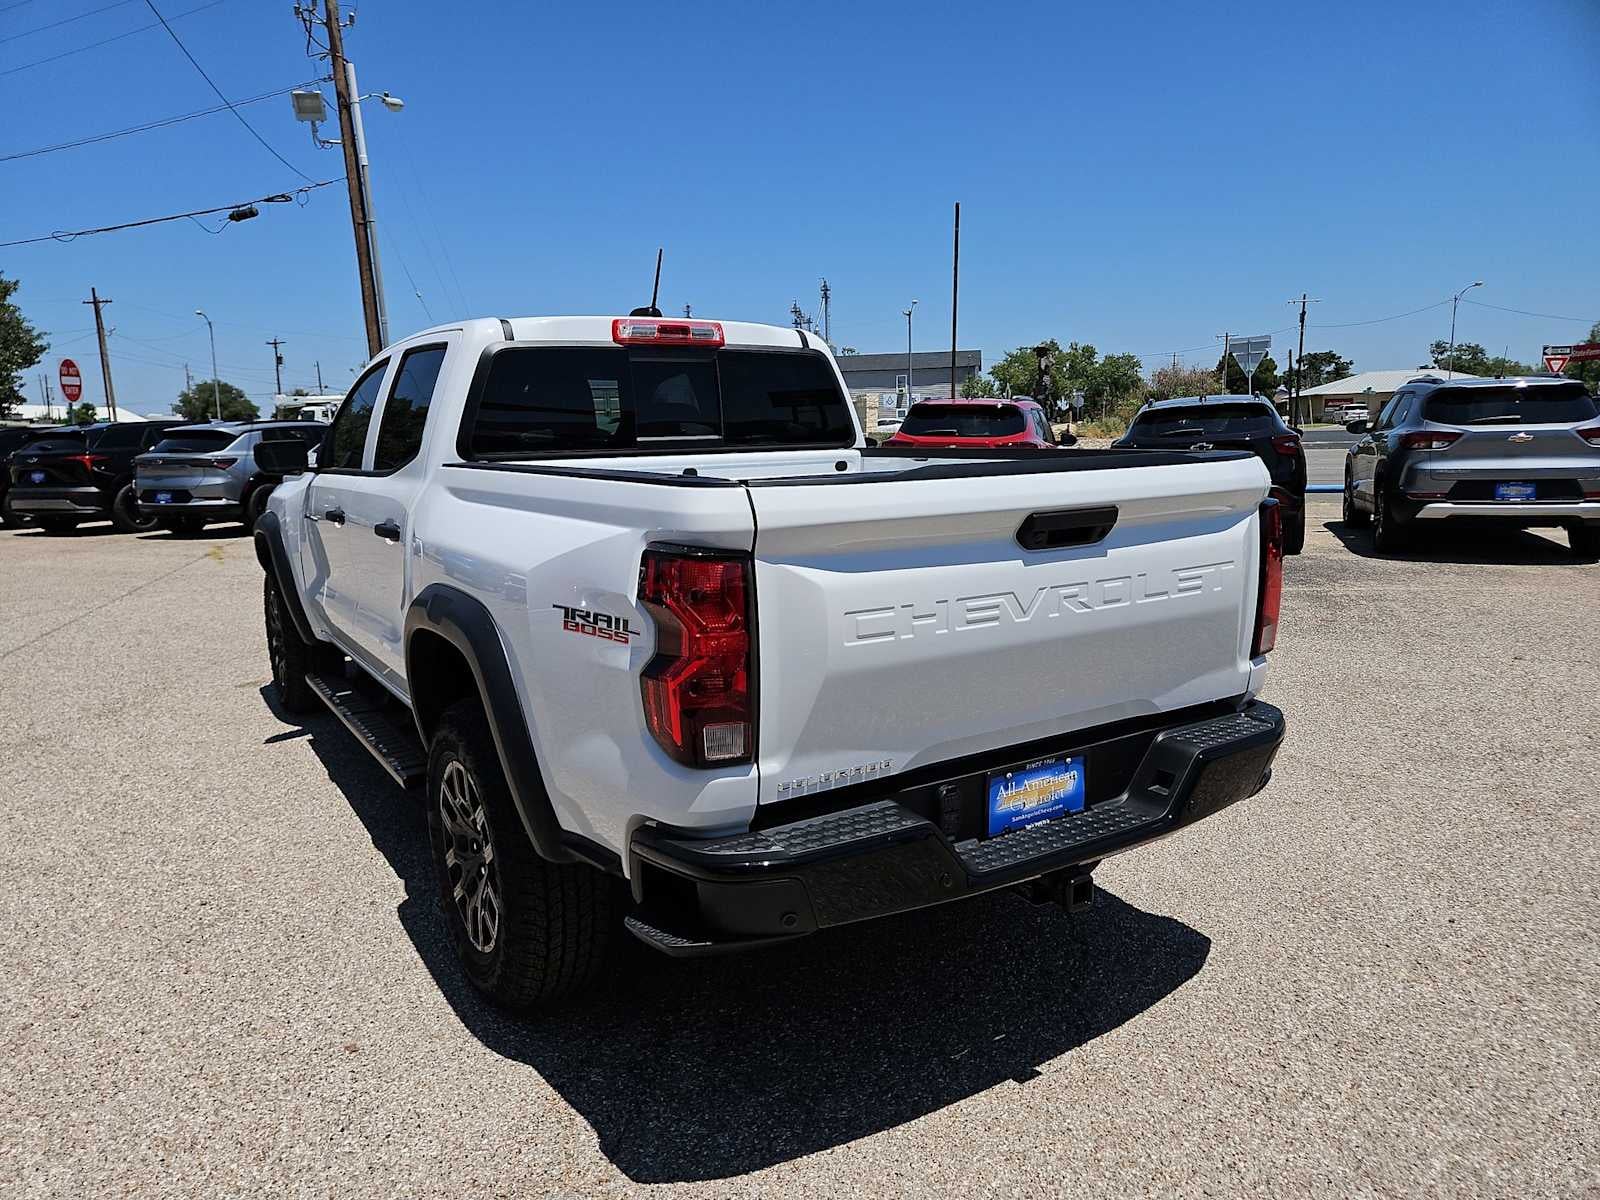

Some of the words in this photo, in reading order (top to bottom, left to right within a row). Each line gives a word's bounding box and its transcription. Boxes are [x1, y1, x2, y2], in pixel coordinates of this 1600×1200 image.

[843, 561, 1235, 646] CHEVROLET
[553, 604, 640, 635] TRAIL
[563, 619, 629, 644] BOSS
[996, 781, 1016, 800] All
[1020, 770, 1078, 793] American
[1009, 787, 1065, 812] Chevrolet
